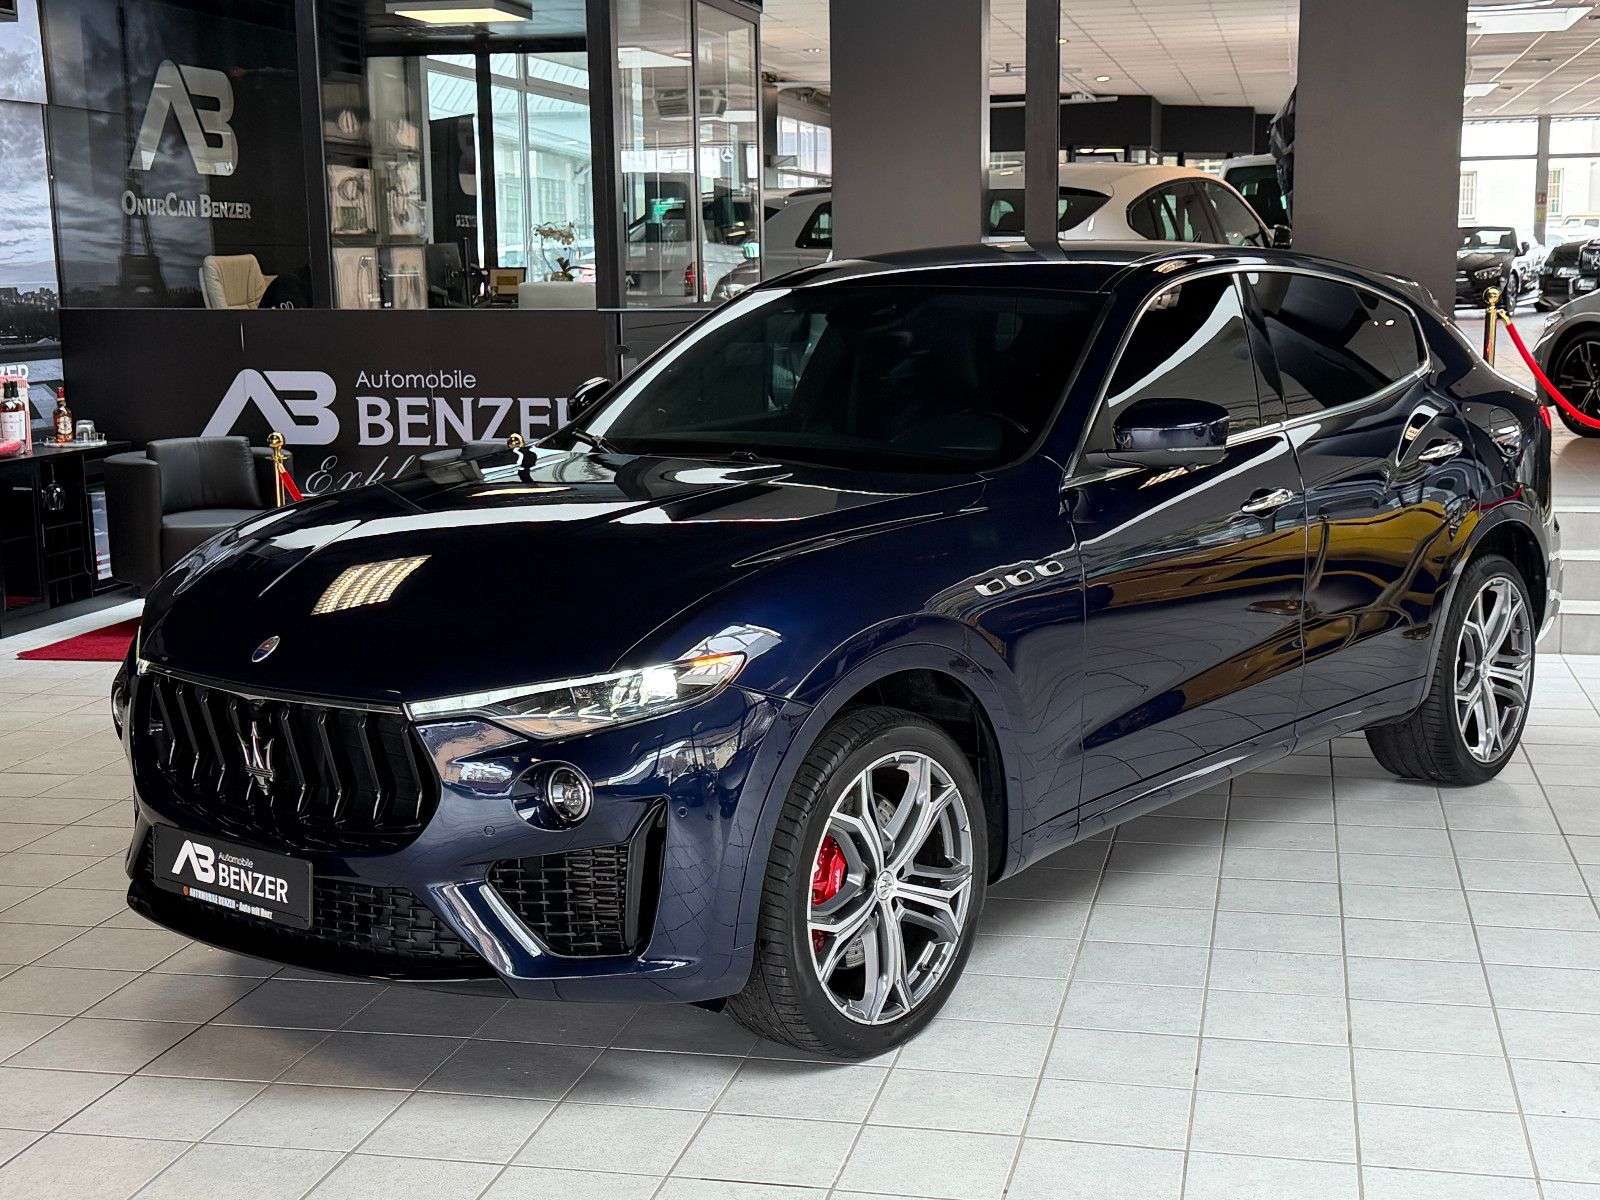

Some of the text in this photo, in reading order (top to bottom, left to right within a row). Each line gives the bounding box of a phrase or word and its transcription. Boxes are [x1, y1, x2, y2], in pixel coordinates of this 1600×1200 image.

[355, 369, 477, 390] Automobile
[218, 852, 254, 869] Automobile
[218, 862, 289, 904] BENZER
